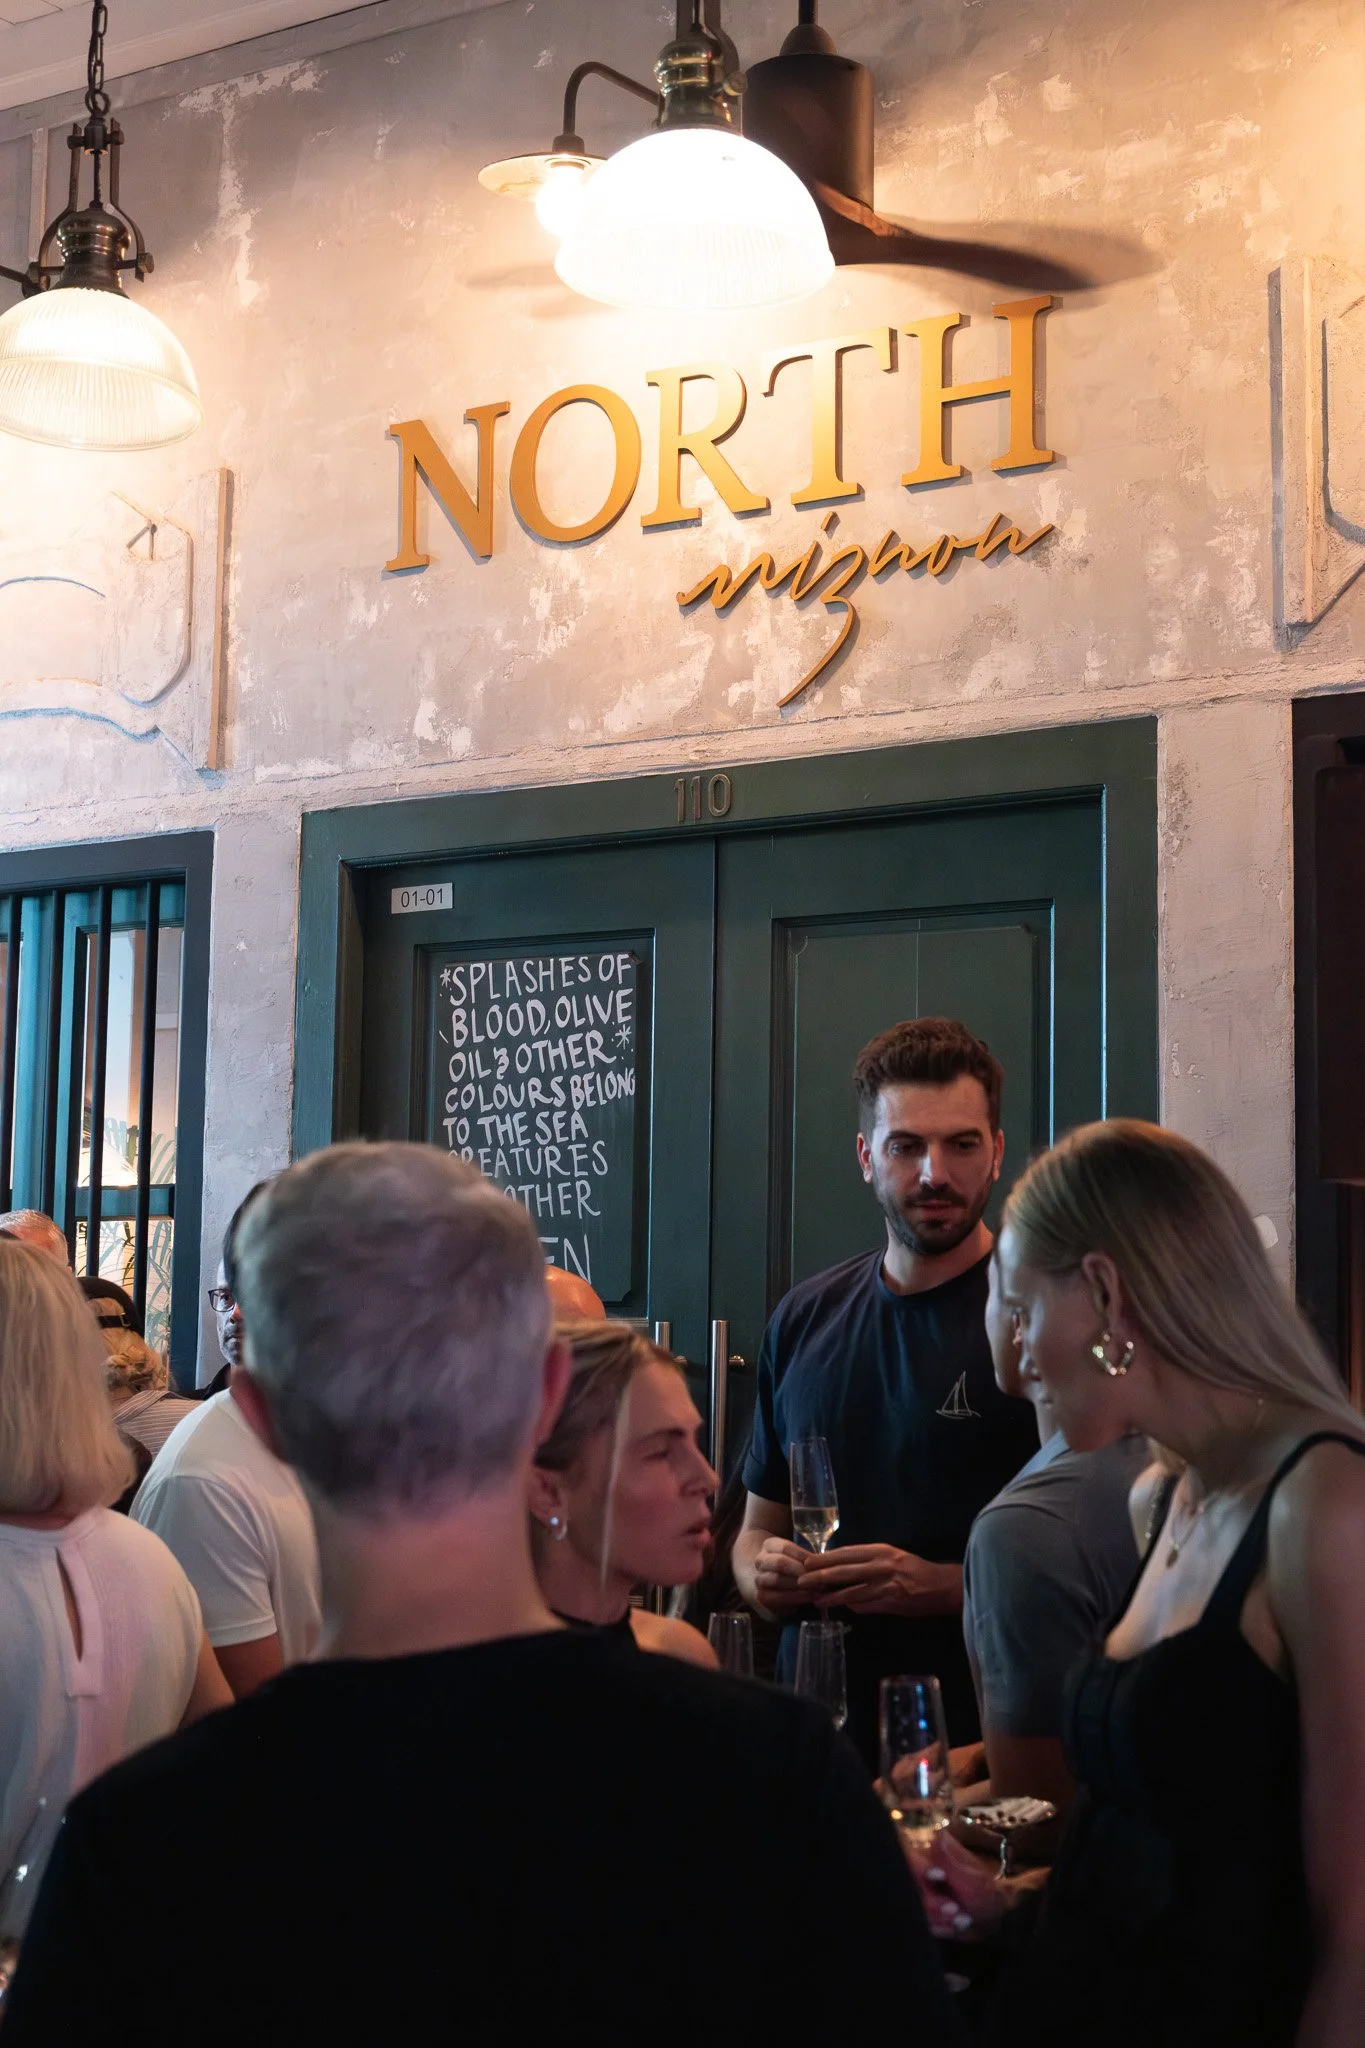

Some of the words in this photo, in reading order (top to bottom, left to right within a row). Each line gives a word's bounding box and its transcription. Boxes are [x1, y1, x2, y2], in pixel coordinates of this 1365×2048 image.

[385, 295, 1056, 572] NORTH
[674, 773, 731, 824] 110
[401, 888, 443, 908] 01-01
[598, 954, 632, 985] OF
[555, 988, 634, 1029] OLIVE
[449, 1050, 492, 1083] OIL
[515, 1029, 617, 1074] OTHER
[445, 1076, 567, 1113] COLOURS
[570, 1067, 636, 1111] BELONG
[443, 1117, 470, 1148] TO
[477, 1111, 531, 1147] THE
[535, 1110, 589, 1145] SEA
[448, 1140, 609, 1179] REATURES
